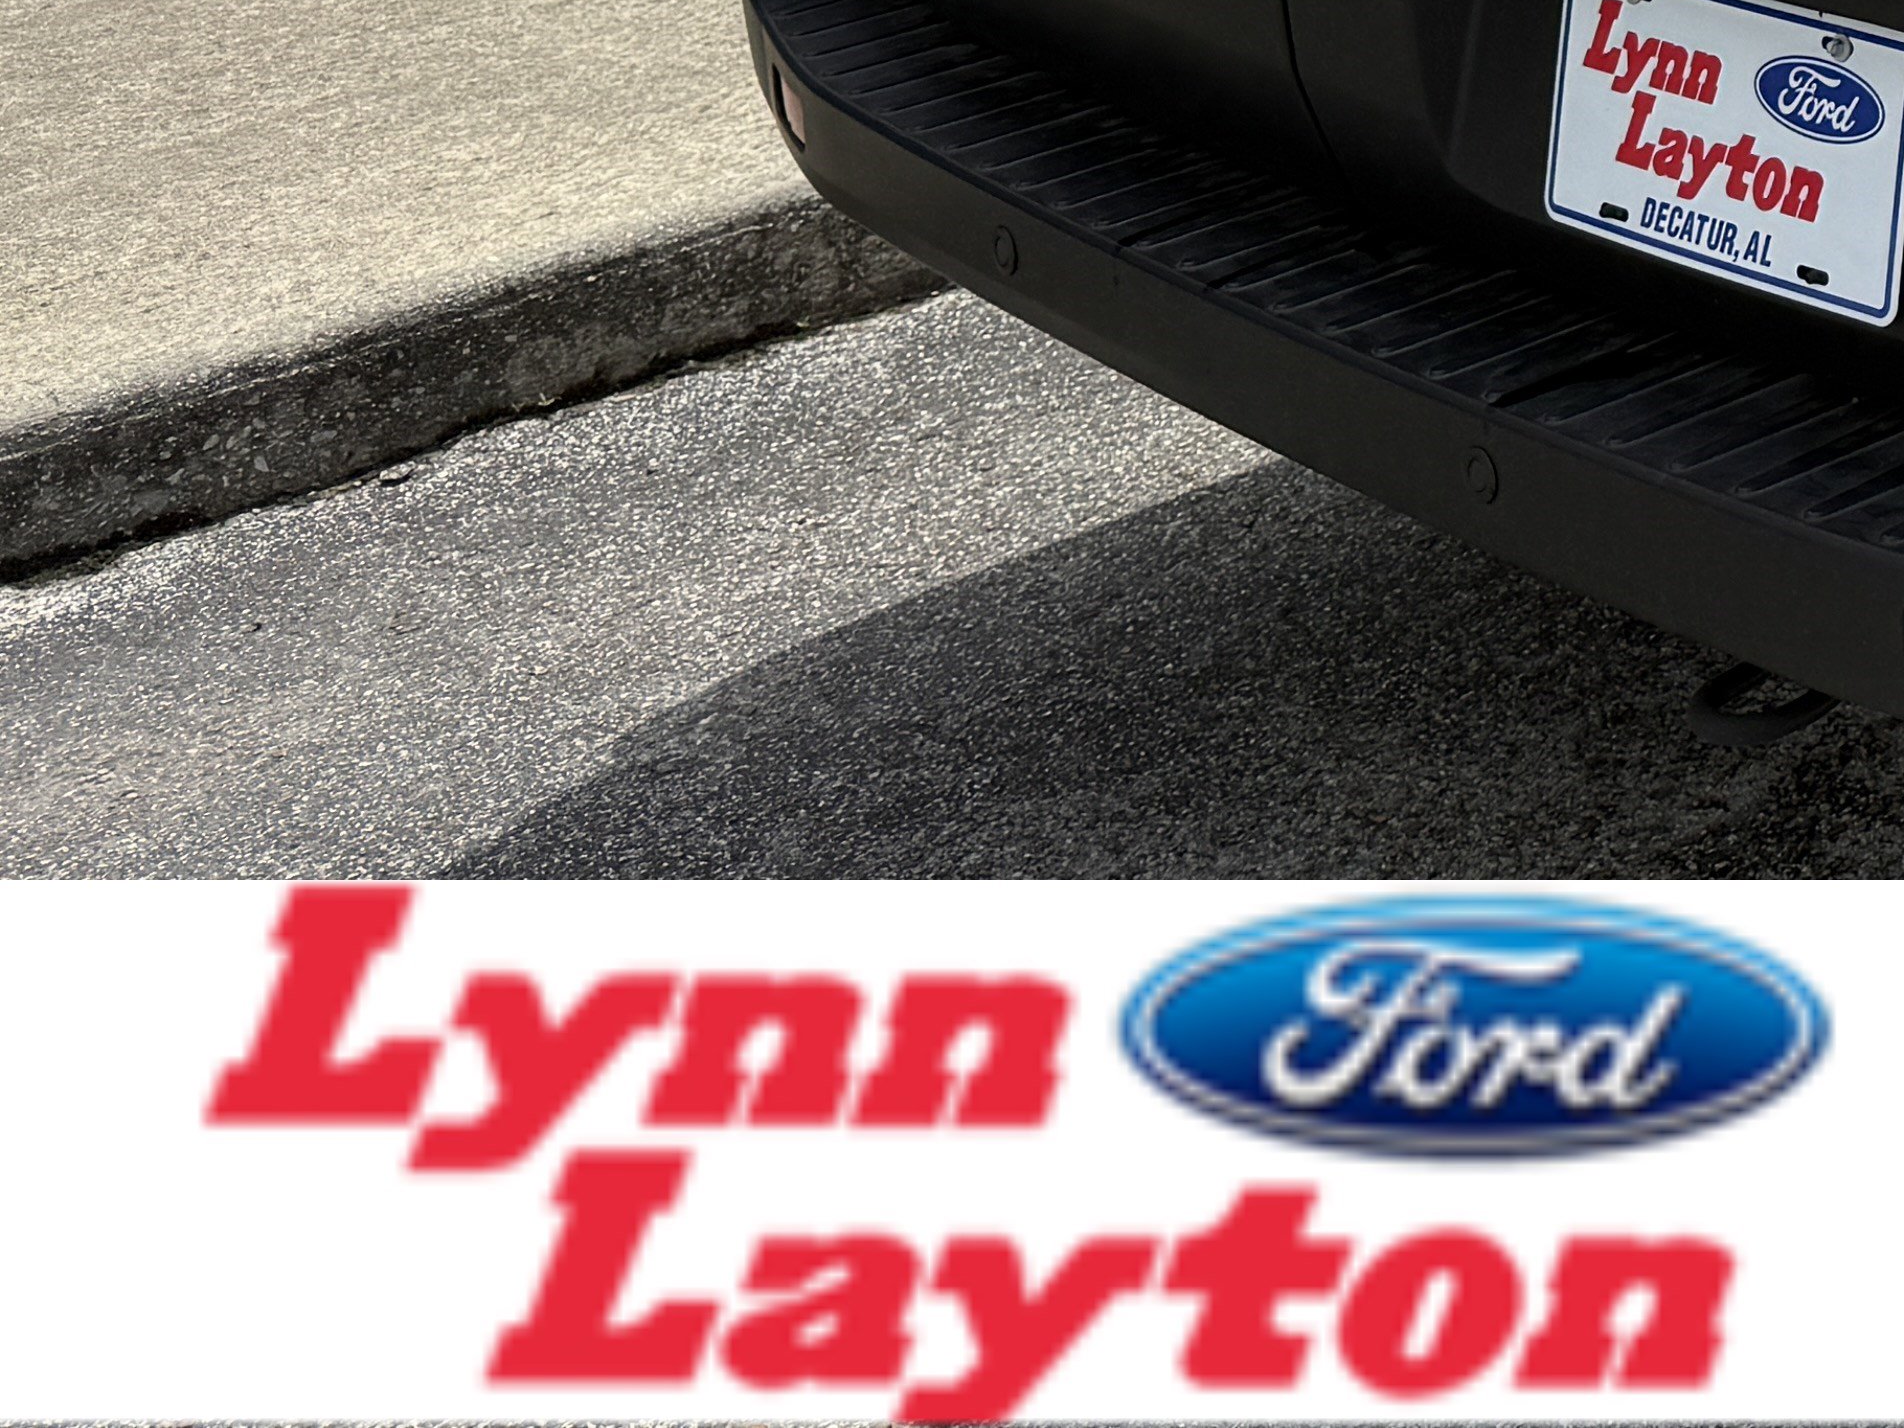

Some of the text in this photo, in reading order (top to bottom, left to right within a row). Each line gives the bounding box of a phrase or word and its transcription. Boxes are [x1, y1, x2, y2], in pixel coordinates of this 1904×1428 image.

[1777, 65, 1860, 133] Ford
[1615, 90, 1825, 224] Layton
[1640, 196, 1772, 267] DECATUR, AL
